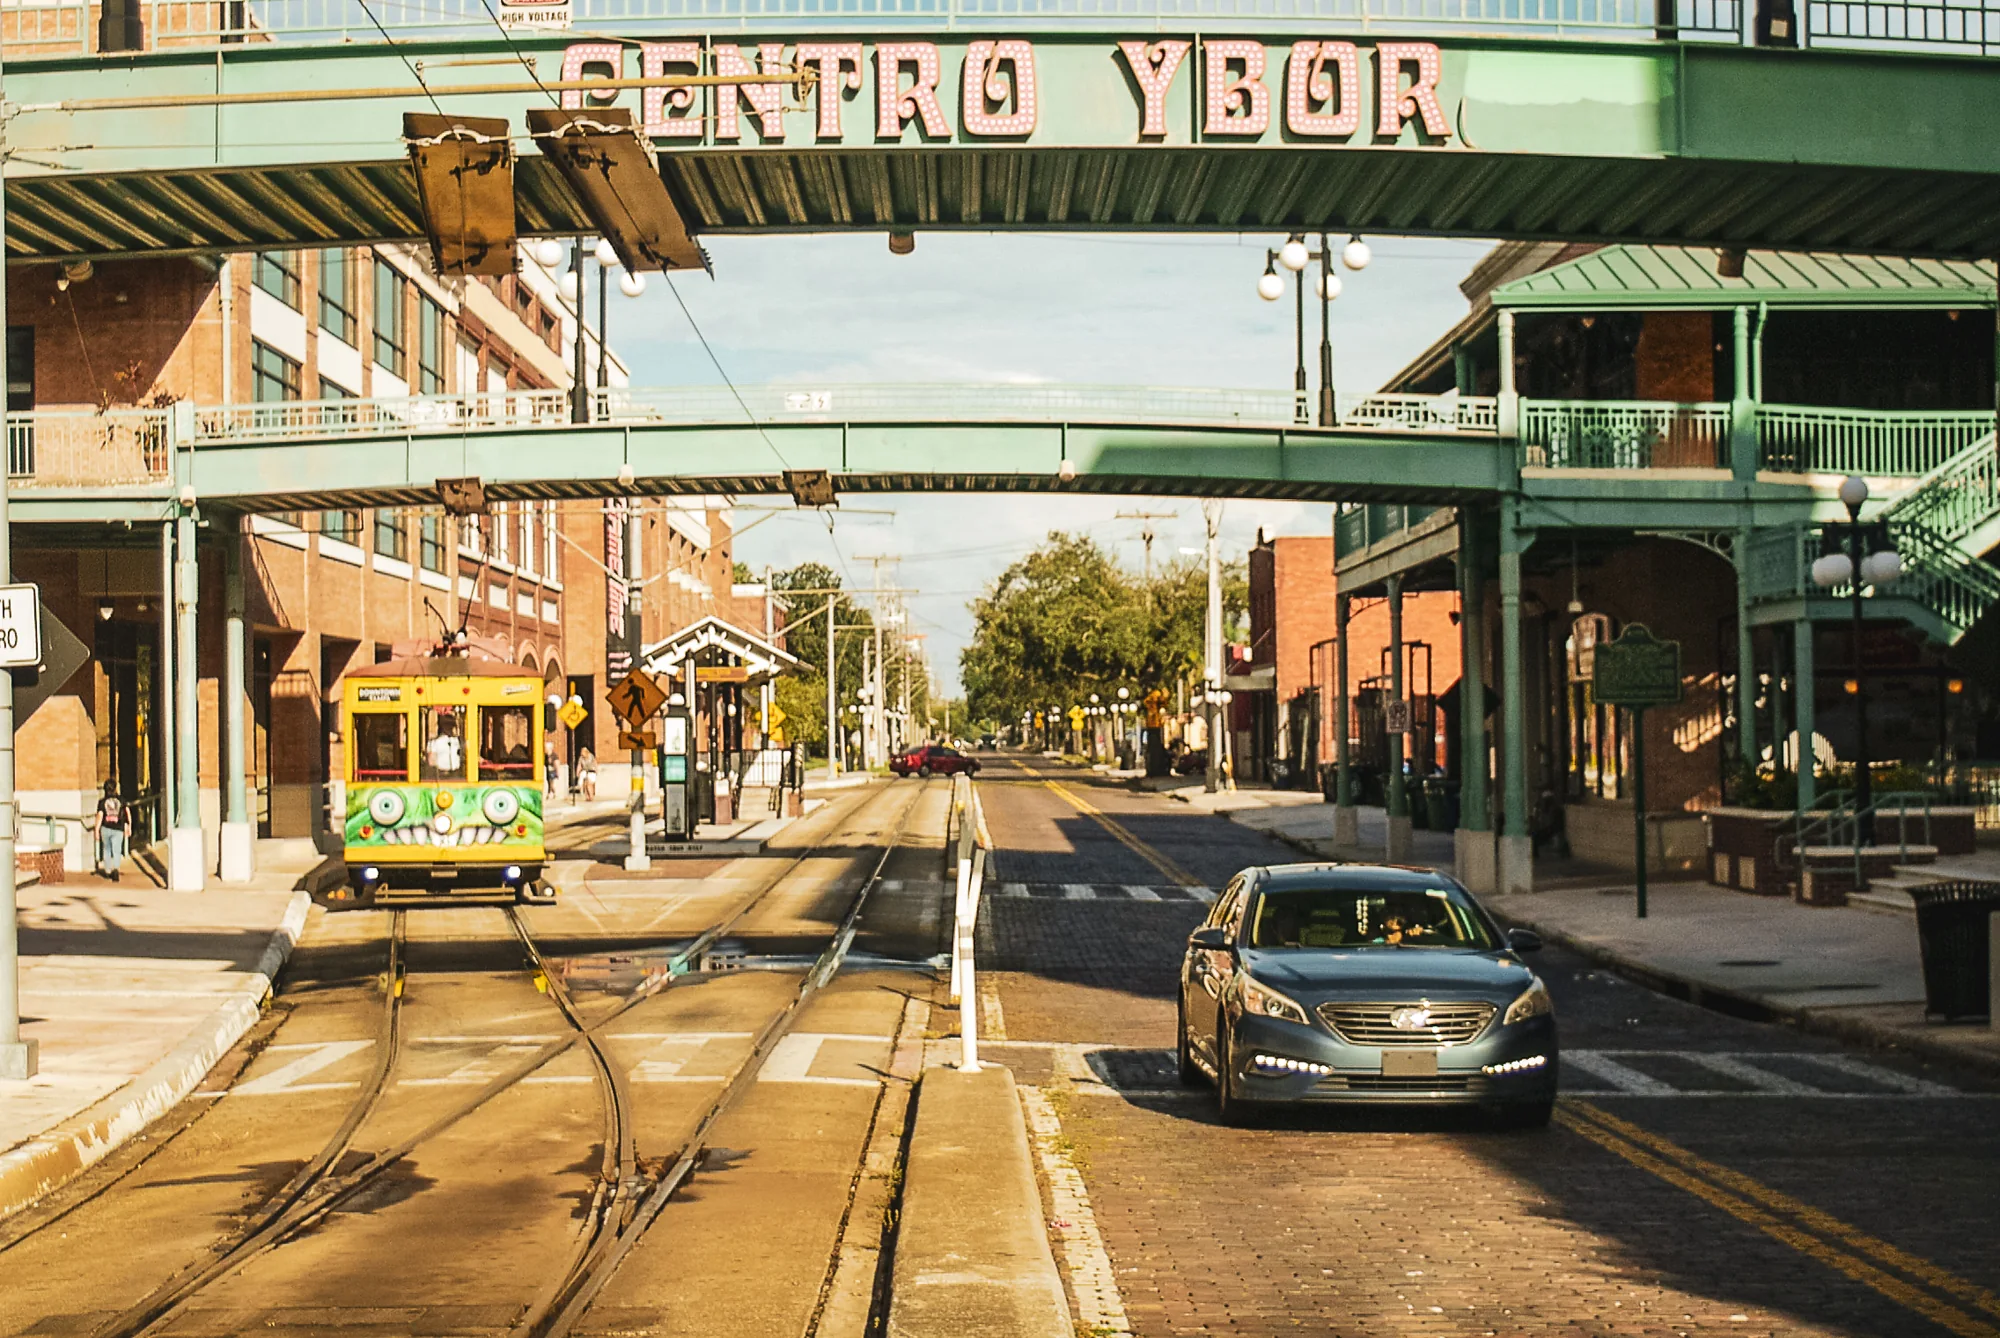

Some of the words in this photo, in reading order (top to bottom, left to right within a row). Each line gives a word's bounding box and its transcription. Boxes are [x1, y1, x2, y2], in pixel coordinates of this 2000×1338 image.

[501, 12, 524, 23] HIGH
[528, 11, 568, 22] VOLTAGE
[560, 40, 1037, 138] CENTRO
[1117, 40, 1453, 137] YBOR
[0, 598, 12, 619] H
